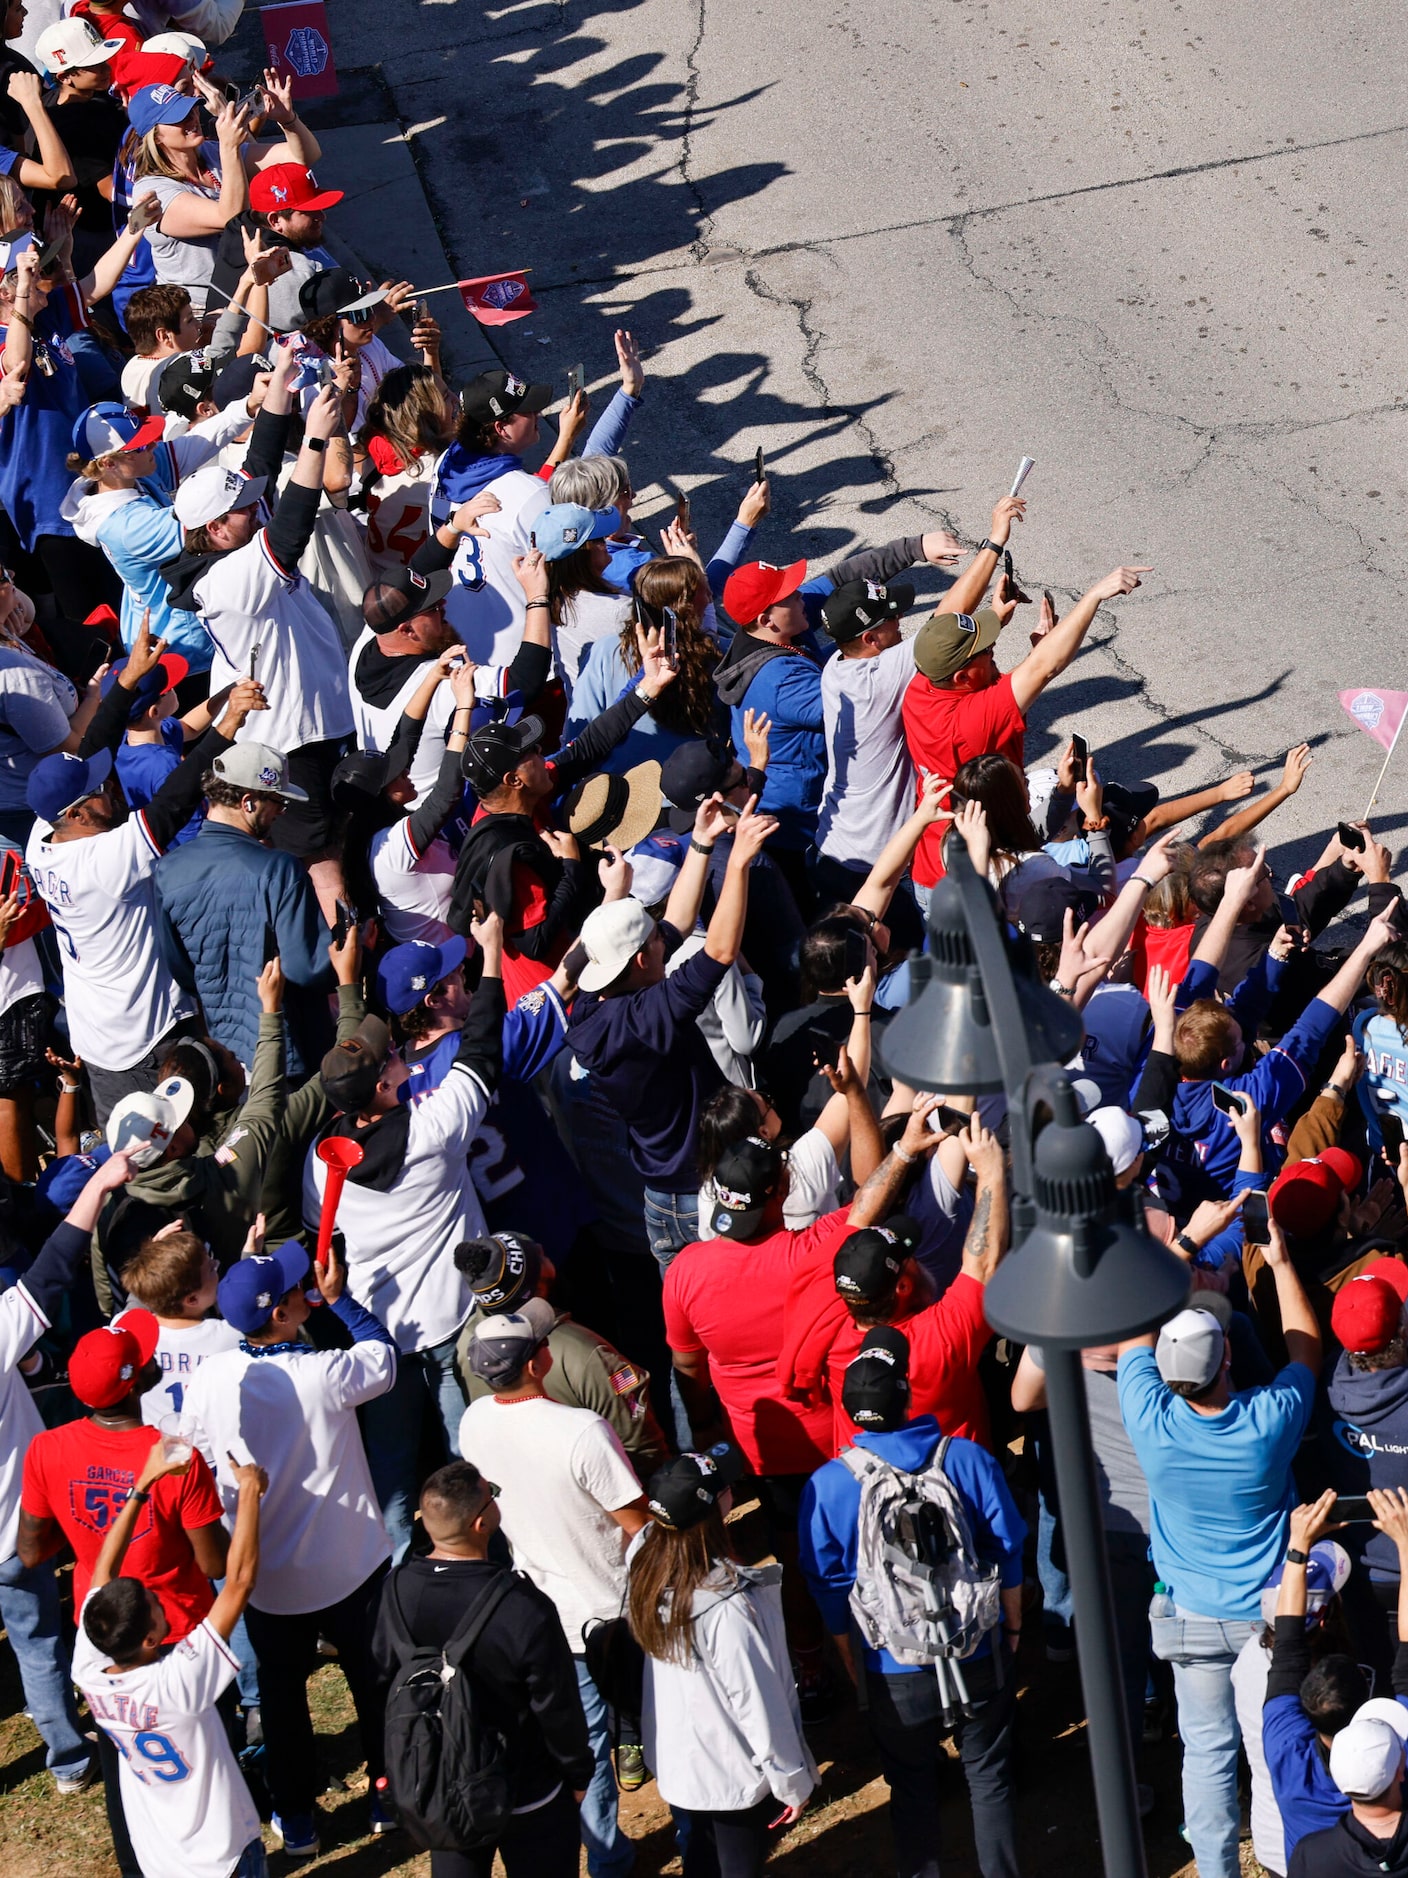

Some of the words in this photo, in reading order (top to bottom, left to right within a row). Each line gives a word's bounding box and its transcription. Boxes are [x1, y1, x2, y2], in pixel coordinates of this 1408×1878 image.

[51, 48, 67, 65] T
[298, 31, 311, 73] CHAMPIONS
[307, 39, 318, 63] WORLD
[457, 532, 487, 592] 3
[1343, 1432, 1382, 1452] PAL
[87, 1464, 135, 1485] GARCIA
